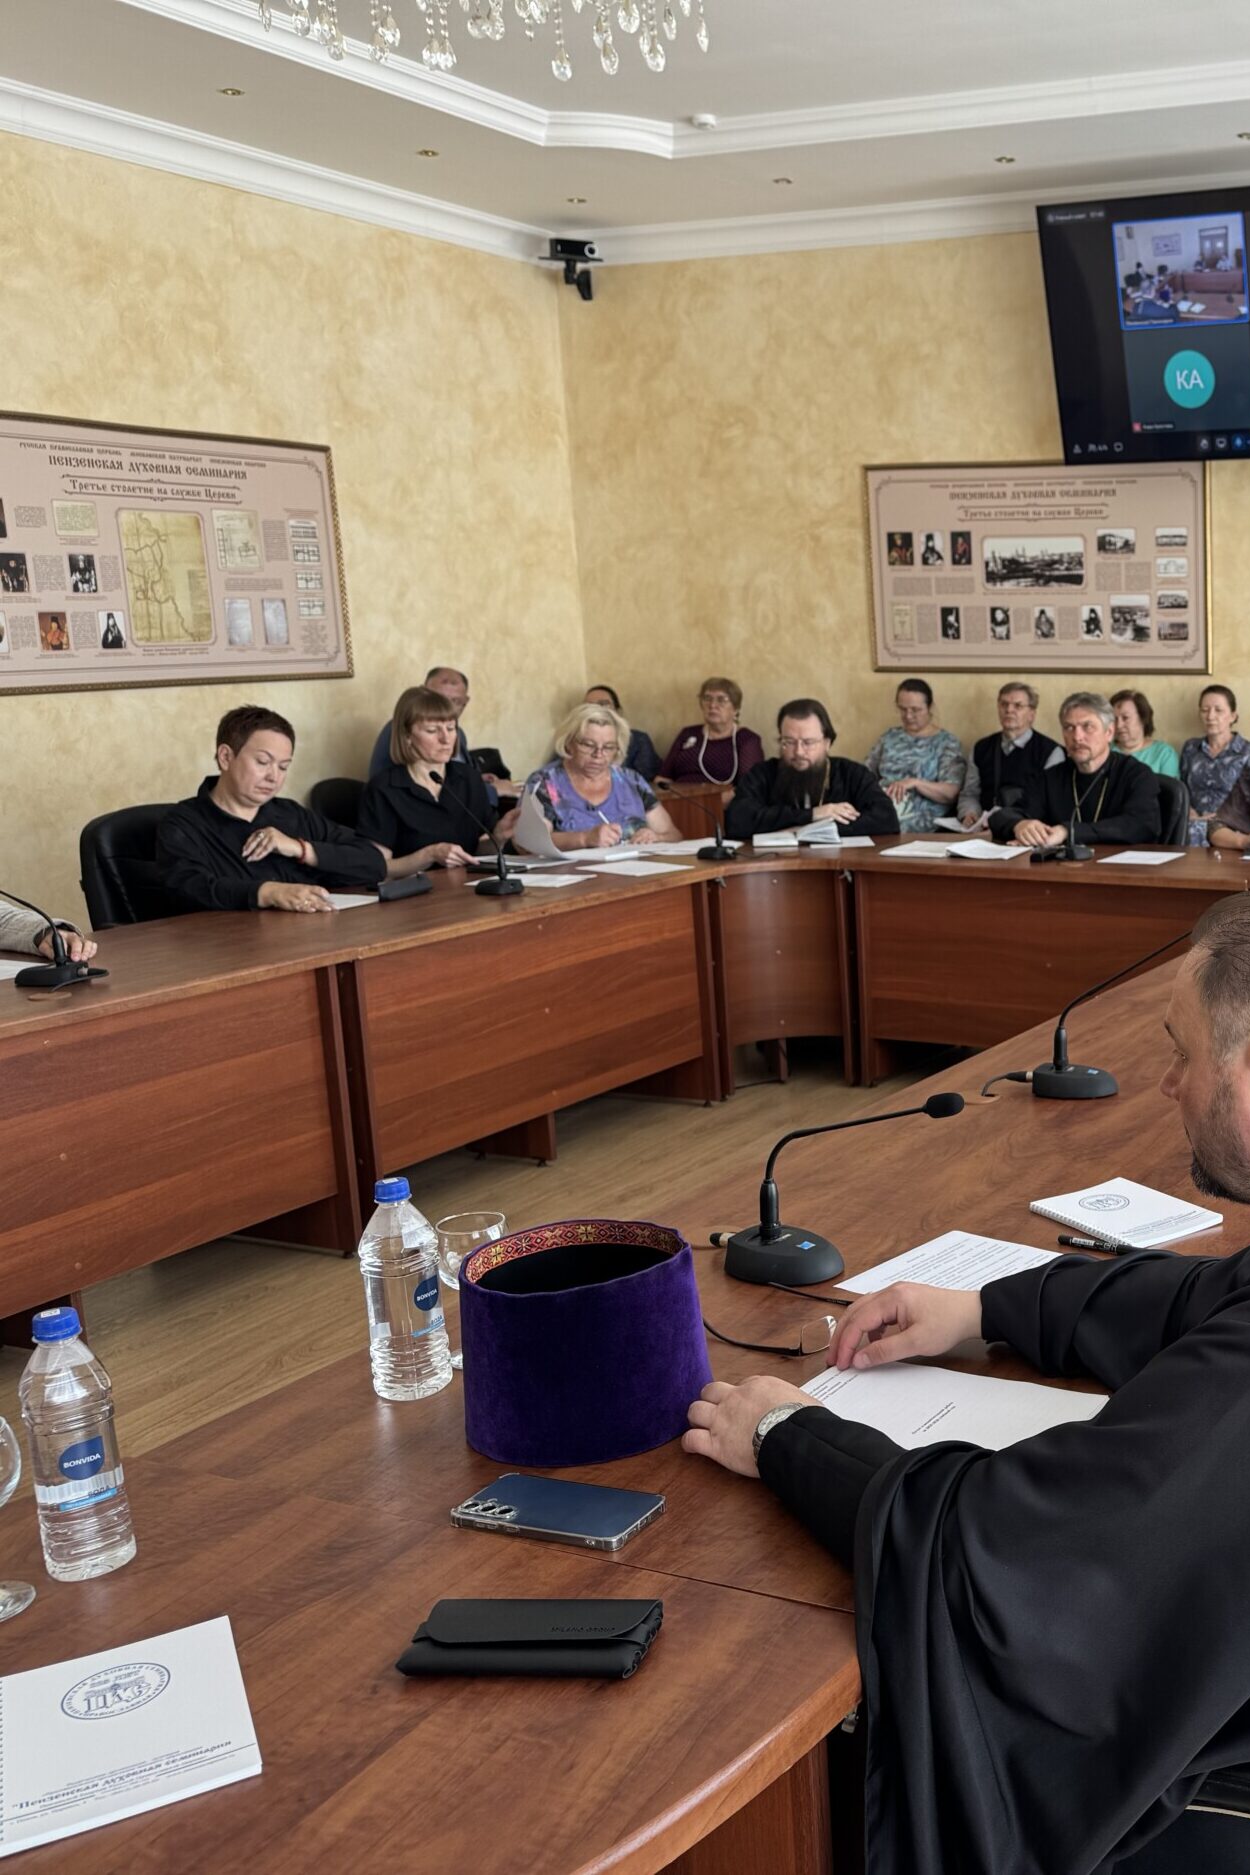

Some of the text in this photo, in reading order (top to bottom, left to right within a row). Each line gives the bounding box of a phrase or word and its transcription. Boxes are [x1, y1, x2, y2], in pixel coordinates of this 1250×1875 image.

[1176, 369, 1204, 389] КА
[48, 455, 247, 480] ПЕНЗЕНСКАЯ ДУХОВНАЯ СЕМИНАРИЯ
[69, 479, 107, 492] Третье
[111, 483, 153, 495] столетие
[157, 486, 168, 495] на
[417, 1289, 437, 1301] BONVIDA
[63, 1453, 101, 1469] BONVIDA
